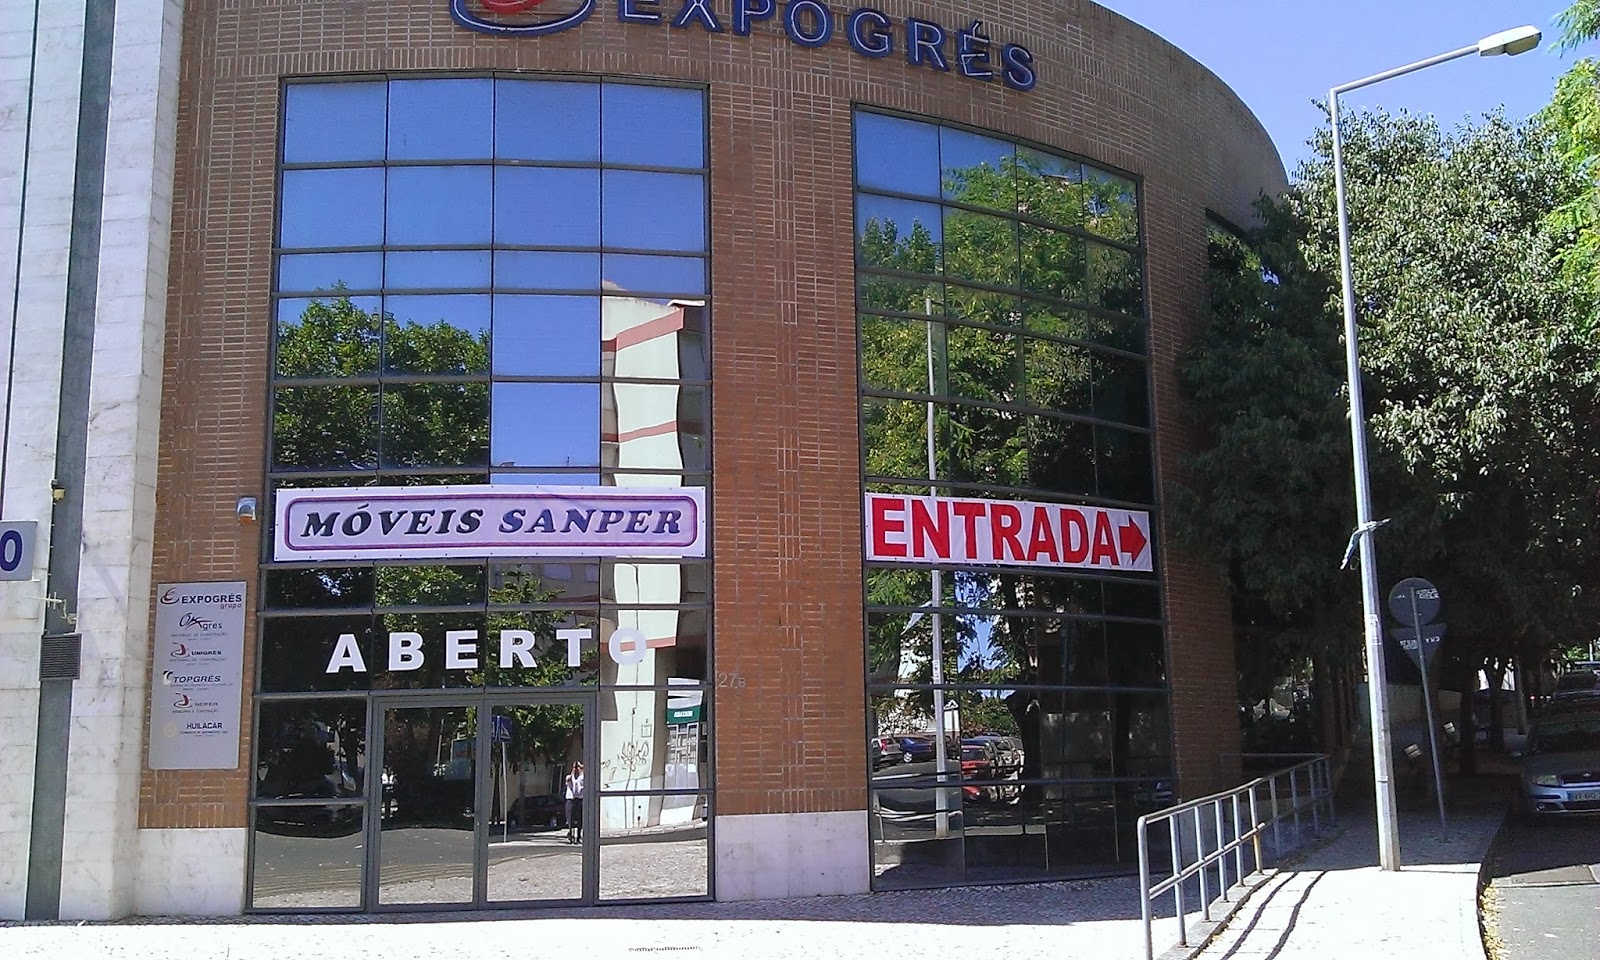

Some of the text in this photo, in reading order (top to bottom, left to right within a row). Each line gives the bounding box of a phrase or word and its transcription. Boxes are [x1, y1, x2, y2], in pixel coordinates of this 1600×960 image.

[616, 0, 1036, 92] EXPOGRÉS
[300, 503, 682, 538] MÓVEIS SANPER
[871, 497, 1120, 566] ENTRADA
[181, 593, 242, 604] EXPOGRÉS
[326, 627, 649, 674] ABERTO
[173, 674, 221, 683] TOPGRÉS
